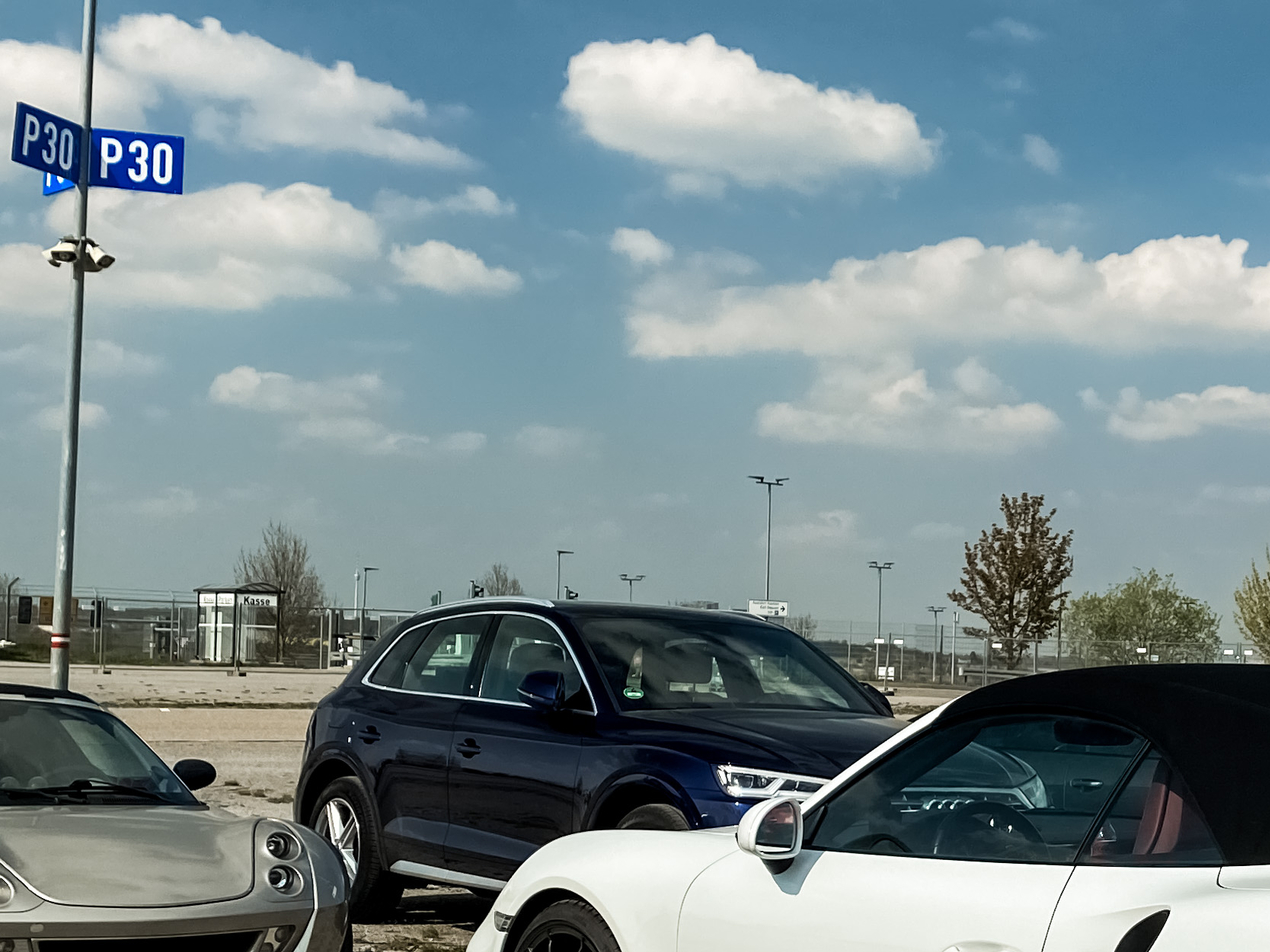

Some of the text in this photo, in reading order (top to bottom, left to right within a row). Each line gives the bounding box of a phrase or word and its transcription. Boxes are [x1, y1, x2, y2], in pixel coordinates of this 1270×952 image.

[22, 112, 74, 171] P30
[100, 136, 174, 185] P30
[243, 595, 271, 606] Kasse
